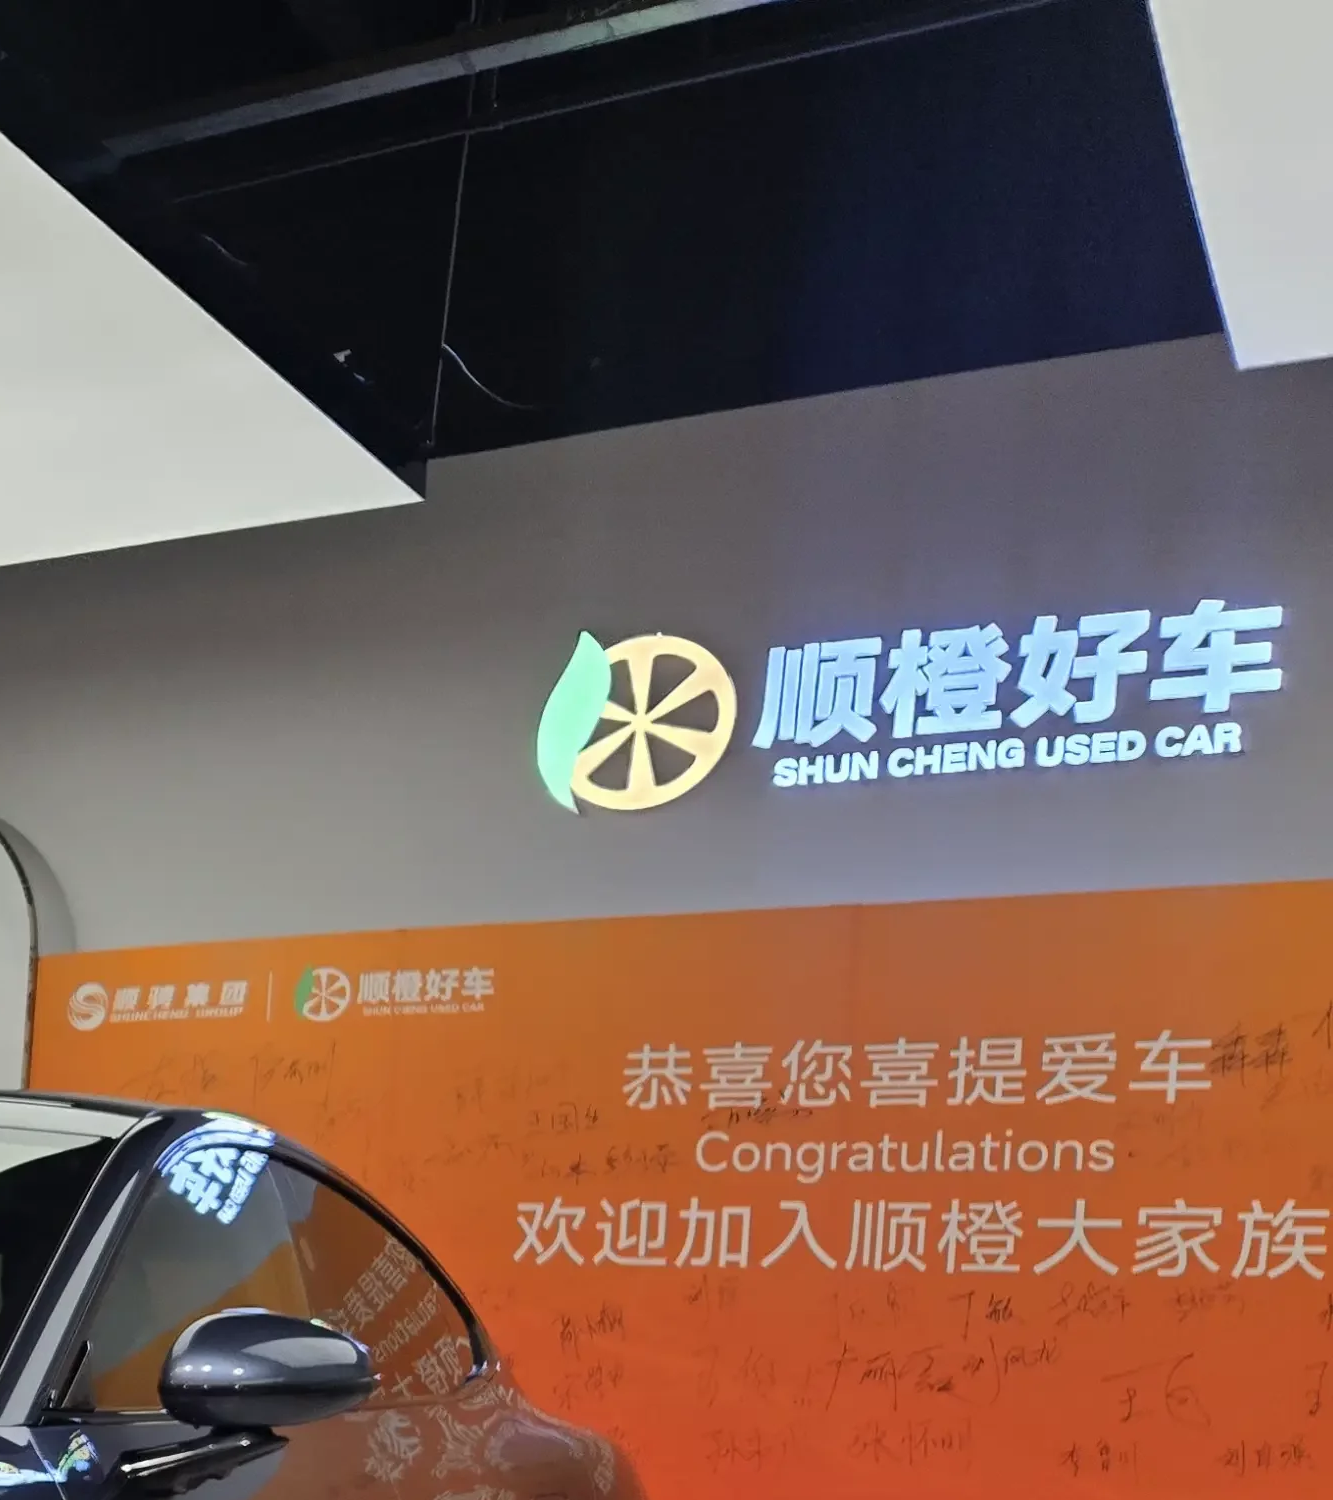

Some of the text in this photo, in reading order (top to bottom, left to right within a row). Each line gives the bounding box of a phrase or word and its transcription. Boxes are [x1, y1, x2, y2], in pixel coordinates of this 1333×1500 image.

[752, 598, 1283, 750] 顺橙好车
[773, 722, 1242, 789] SHUN CHENG USED CAR
[357, 966, 494, 1004] 顺橙好车
[622, 1029, 1214, 1112] 恭喜您喜提爱车
[694, 1128, 1115, 1184] Congratulations
[513, 1196, 1330, 1281] 欢迎加入顺橙大家族
